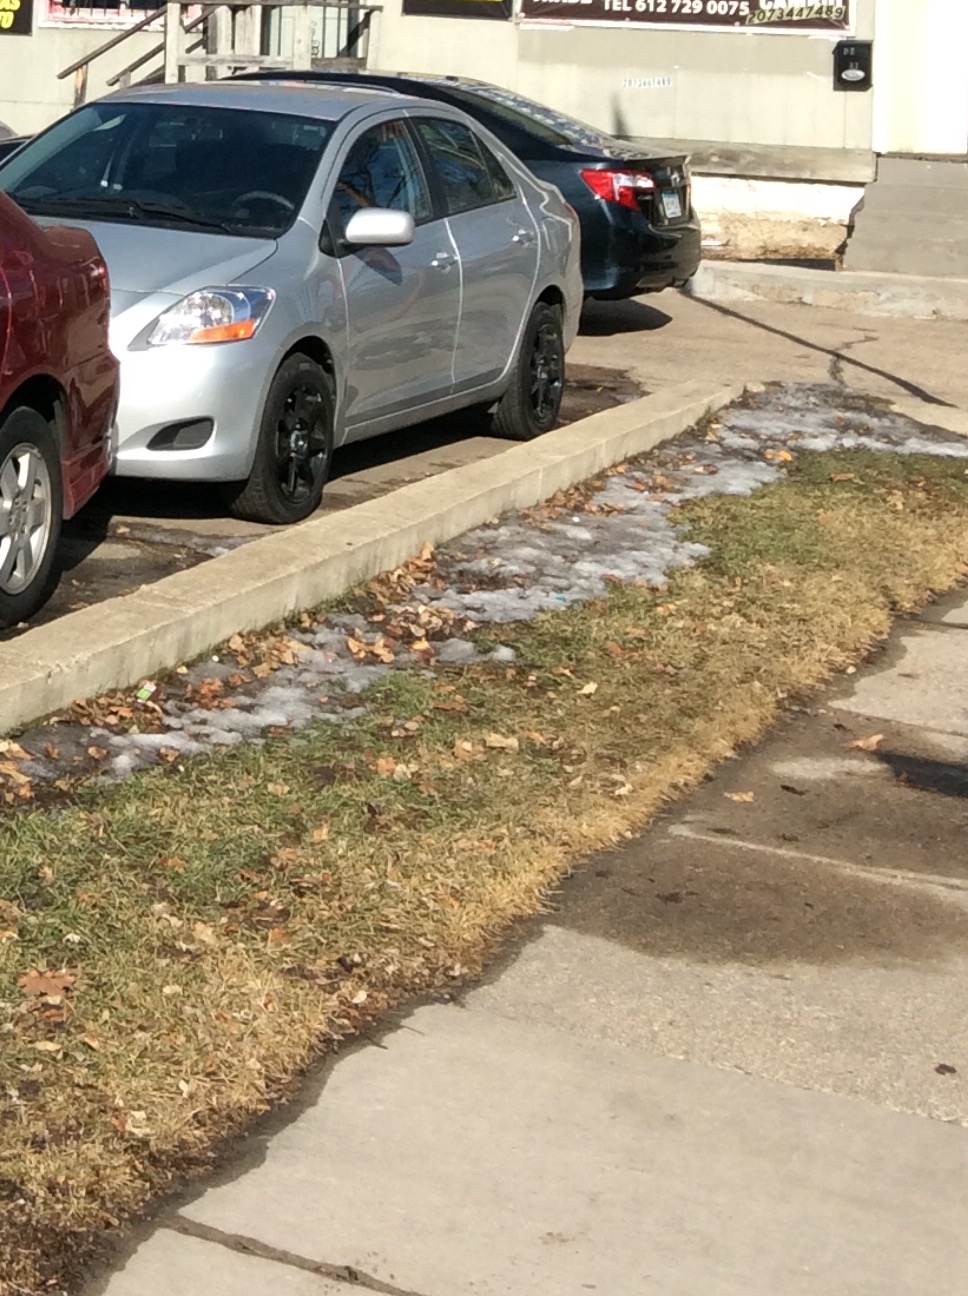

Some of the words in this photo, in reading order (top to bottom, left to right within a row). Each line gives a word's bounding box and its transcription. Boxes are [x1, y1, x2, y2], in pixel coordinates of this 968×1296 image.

[671, 0, 703, 14] 729
[706, 0, 750, 16] 0075
[747, 6, 844, 24] 2073447489
